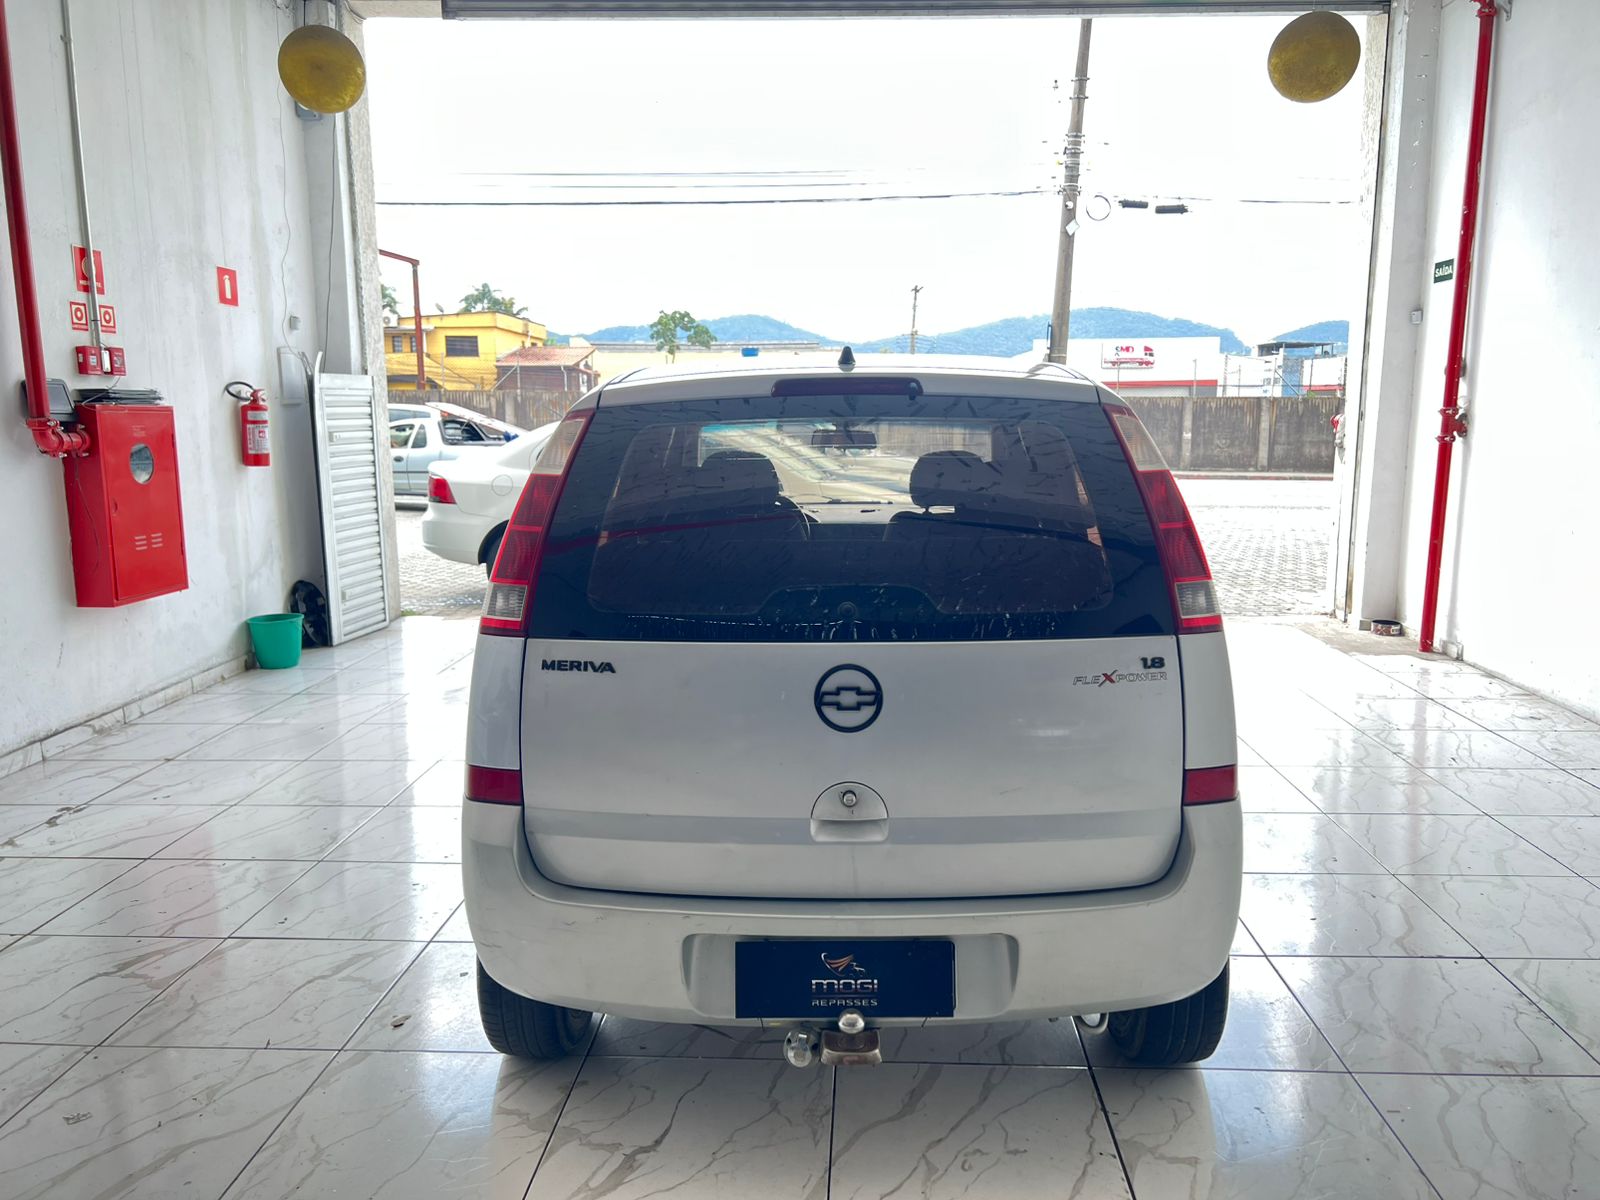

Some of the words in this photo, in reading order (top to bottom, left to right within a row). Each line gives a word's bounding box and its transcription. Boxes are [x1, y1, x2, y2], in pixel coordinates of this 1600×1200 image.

[541, 659, 616, 673] MERIVA
[1140, 656, 1165, 669] 1.8
[811, 979, 878, 992] MOGI
[811, 999, 878, 1007] REPASSES
